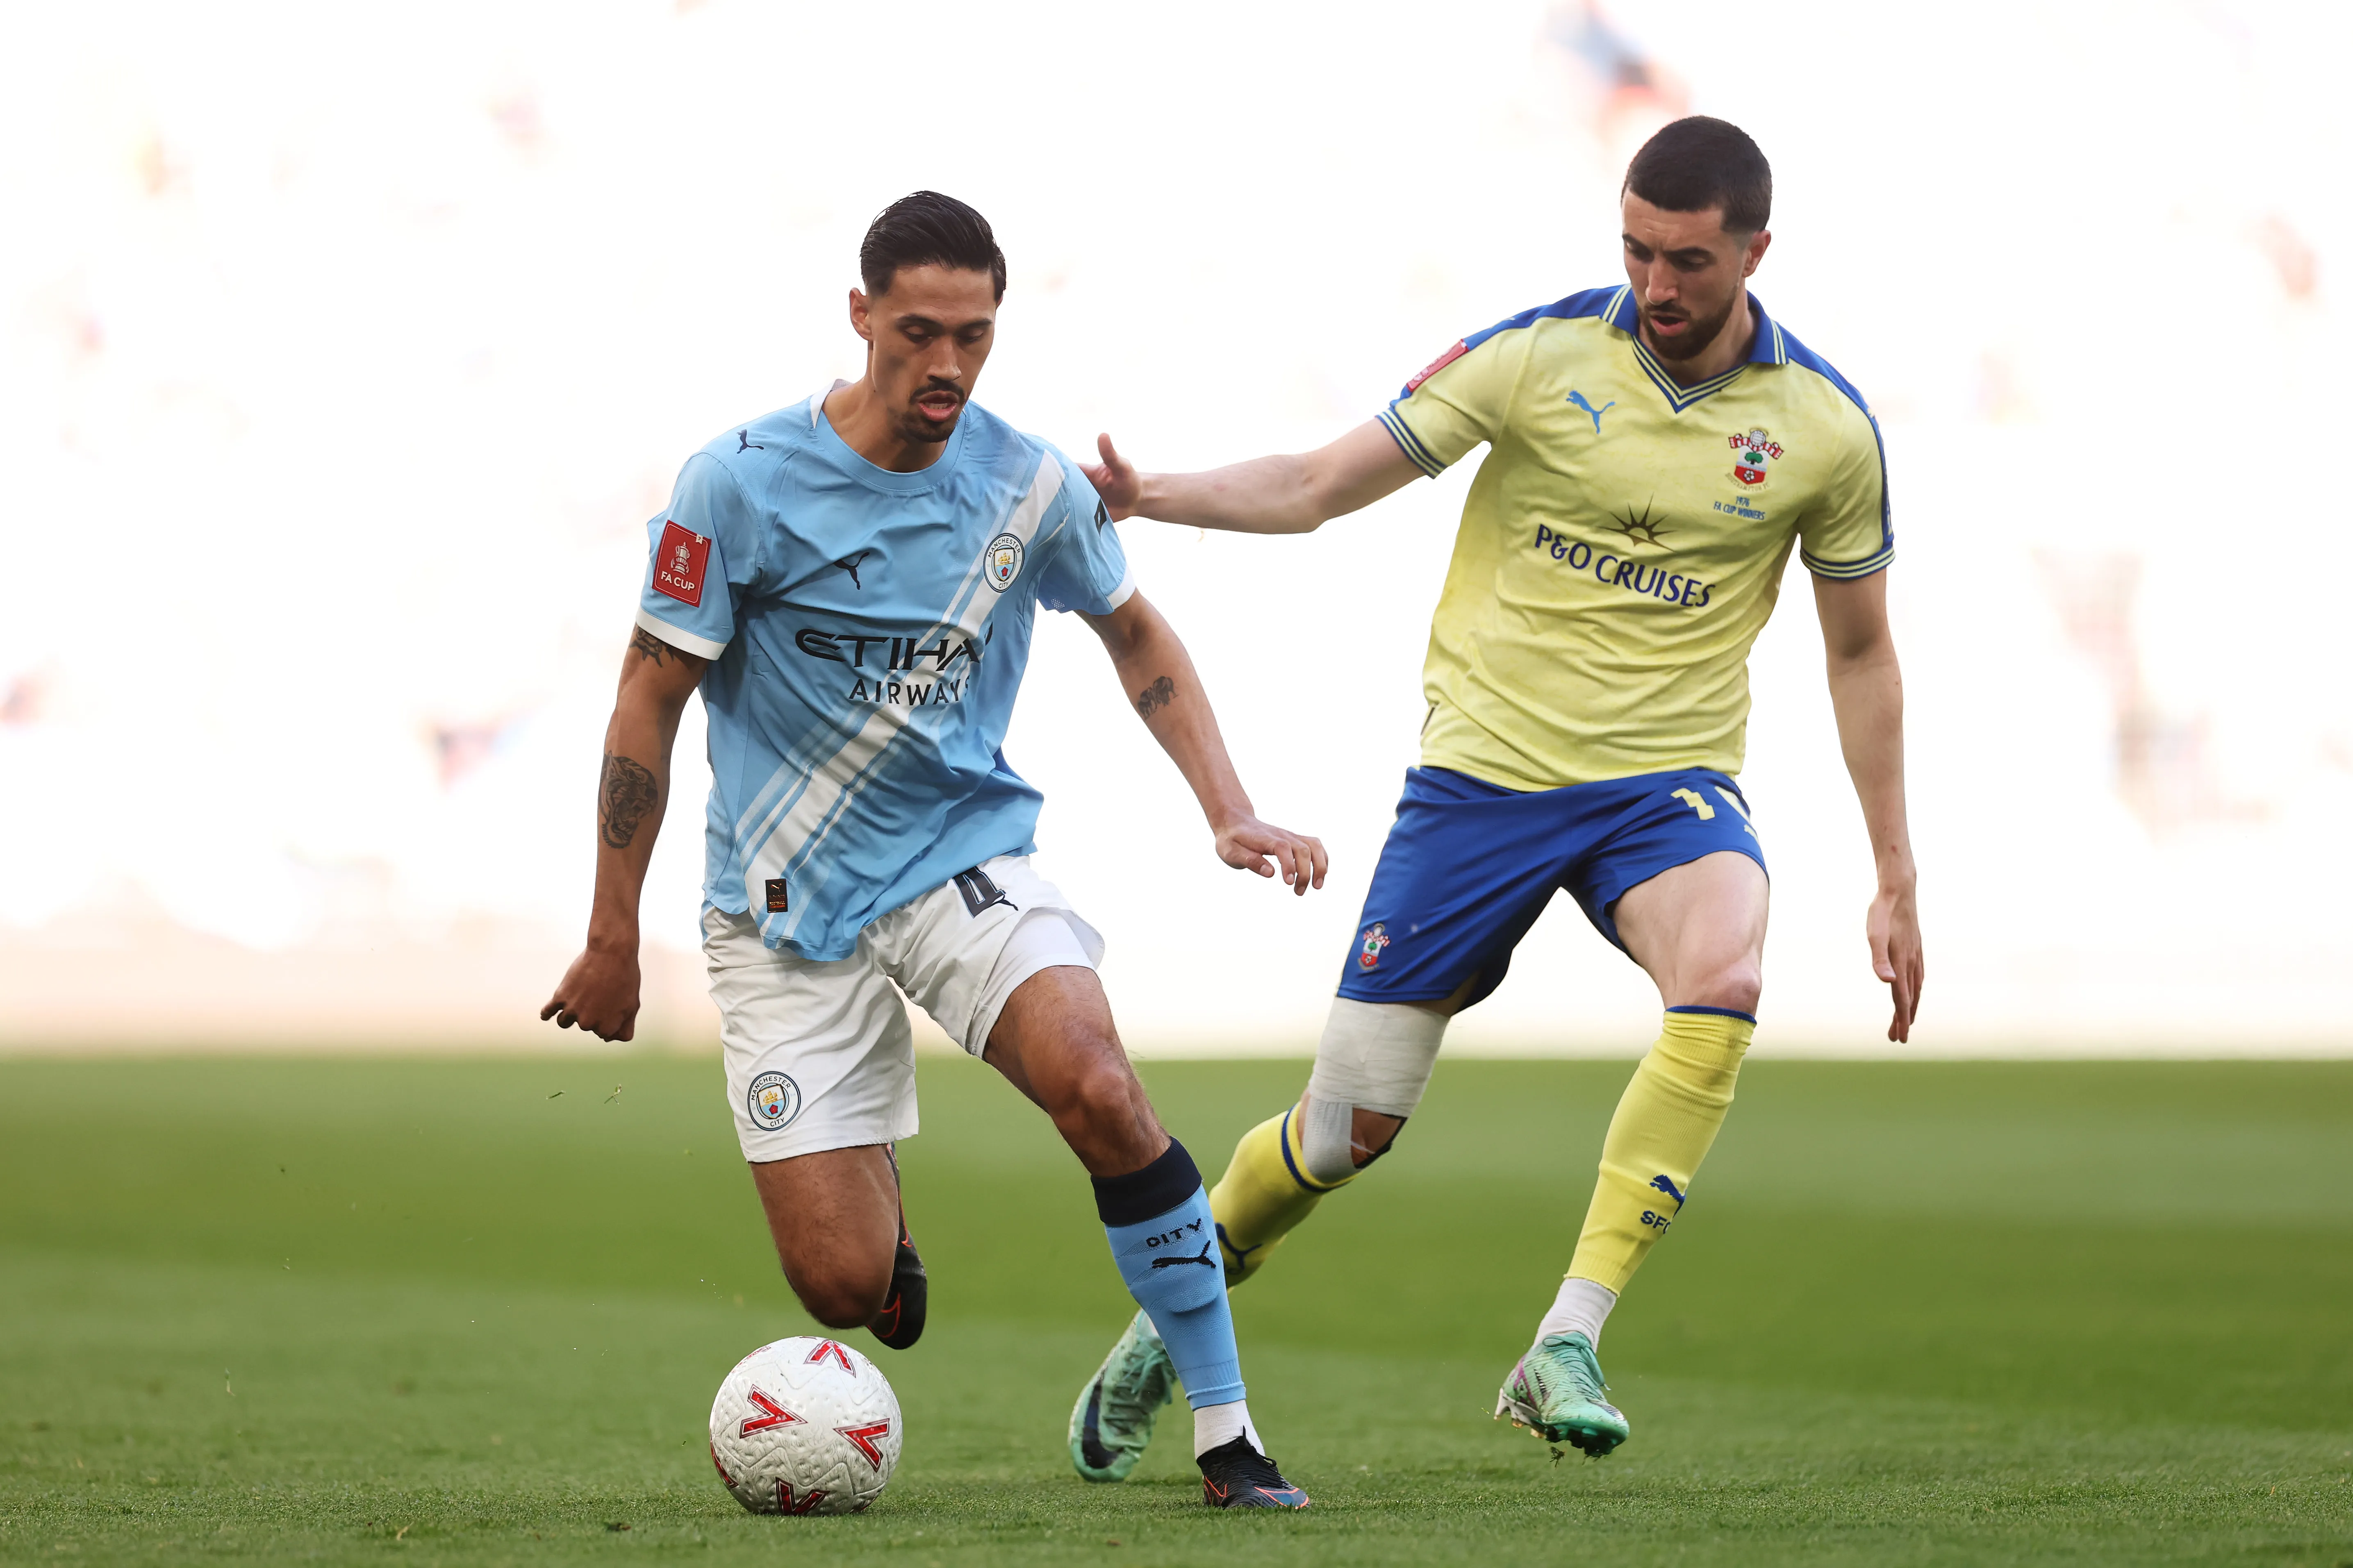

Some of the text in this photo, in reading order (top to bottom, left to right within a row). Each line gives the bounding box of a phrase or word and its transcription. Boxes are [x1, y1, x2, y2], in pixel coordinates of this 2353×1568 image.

[988, 538, 1021, 558] MANCHESTER
[1534, 523, 1716, 607] P&O CRUISES
[661, 570, 695, 591] FA CUP
[751, 1076, 791, 1100] MANCHESTER
[770, 1117, 785, 1127] CITY
[1146, 1218, 1201, 1247] CITY
